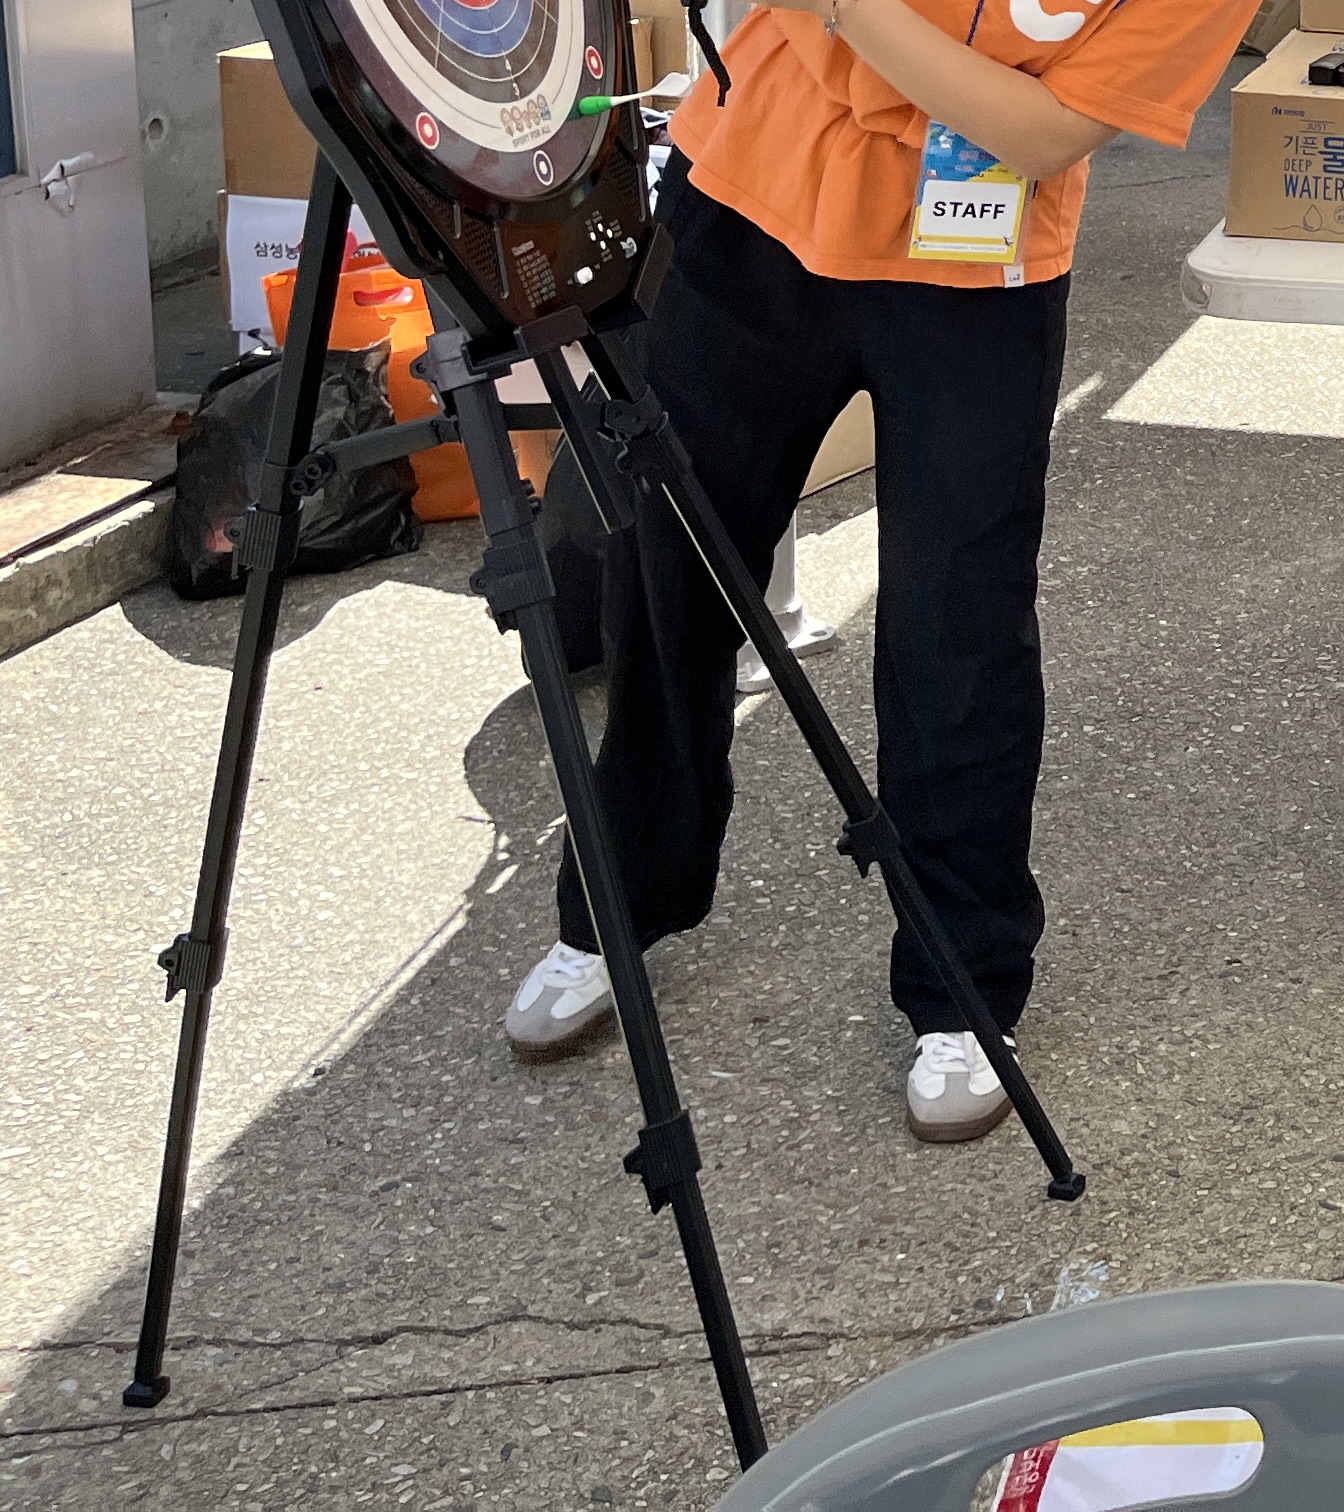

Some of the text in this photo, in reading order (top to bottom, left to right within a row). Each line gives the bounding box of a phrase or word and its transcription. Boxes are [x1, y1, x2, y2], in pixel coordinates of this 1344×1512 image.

[1283, 158, 1312, 172] DEEP
[932, 200, 1006, 220] STAFF
[254, 241, 300, 260] 삼성농
